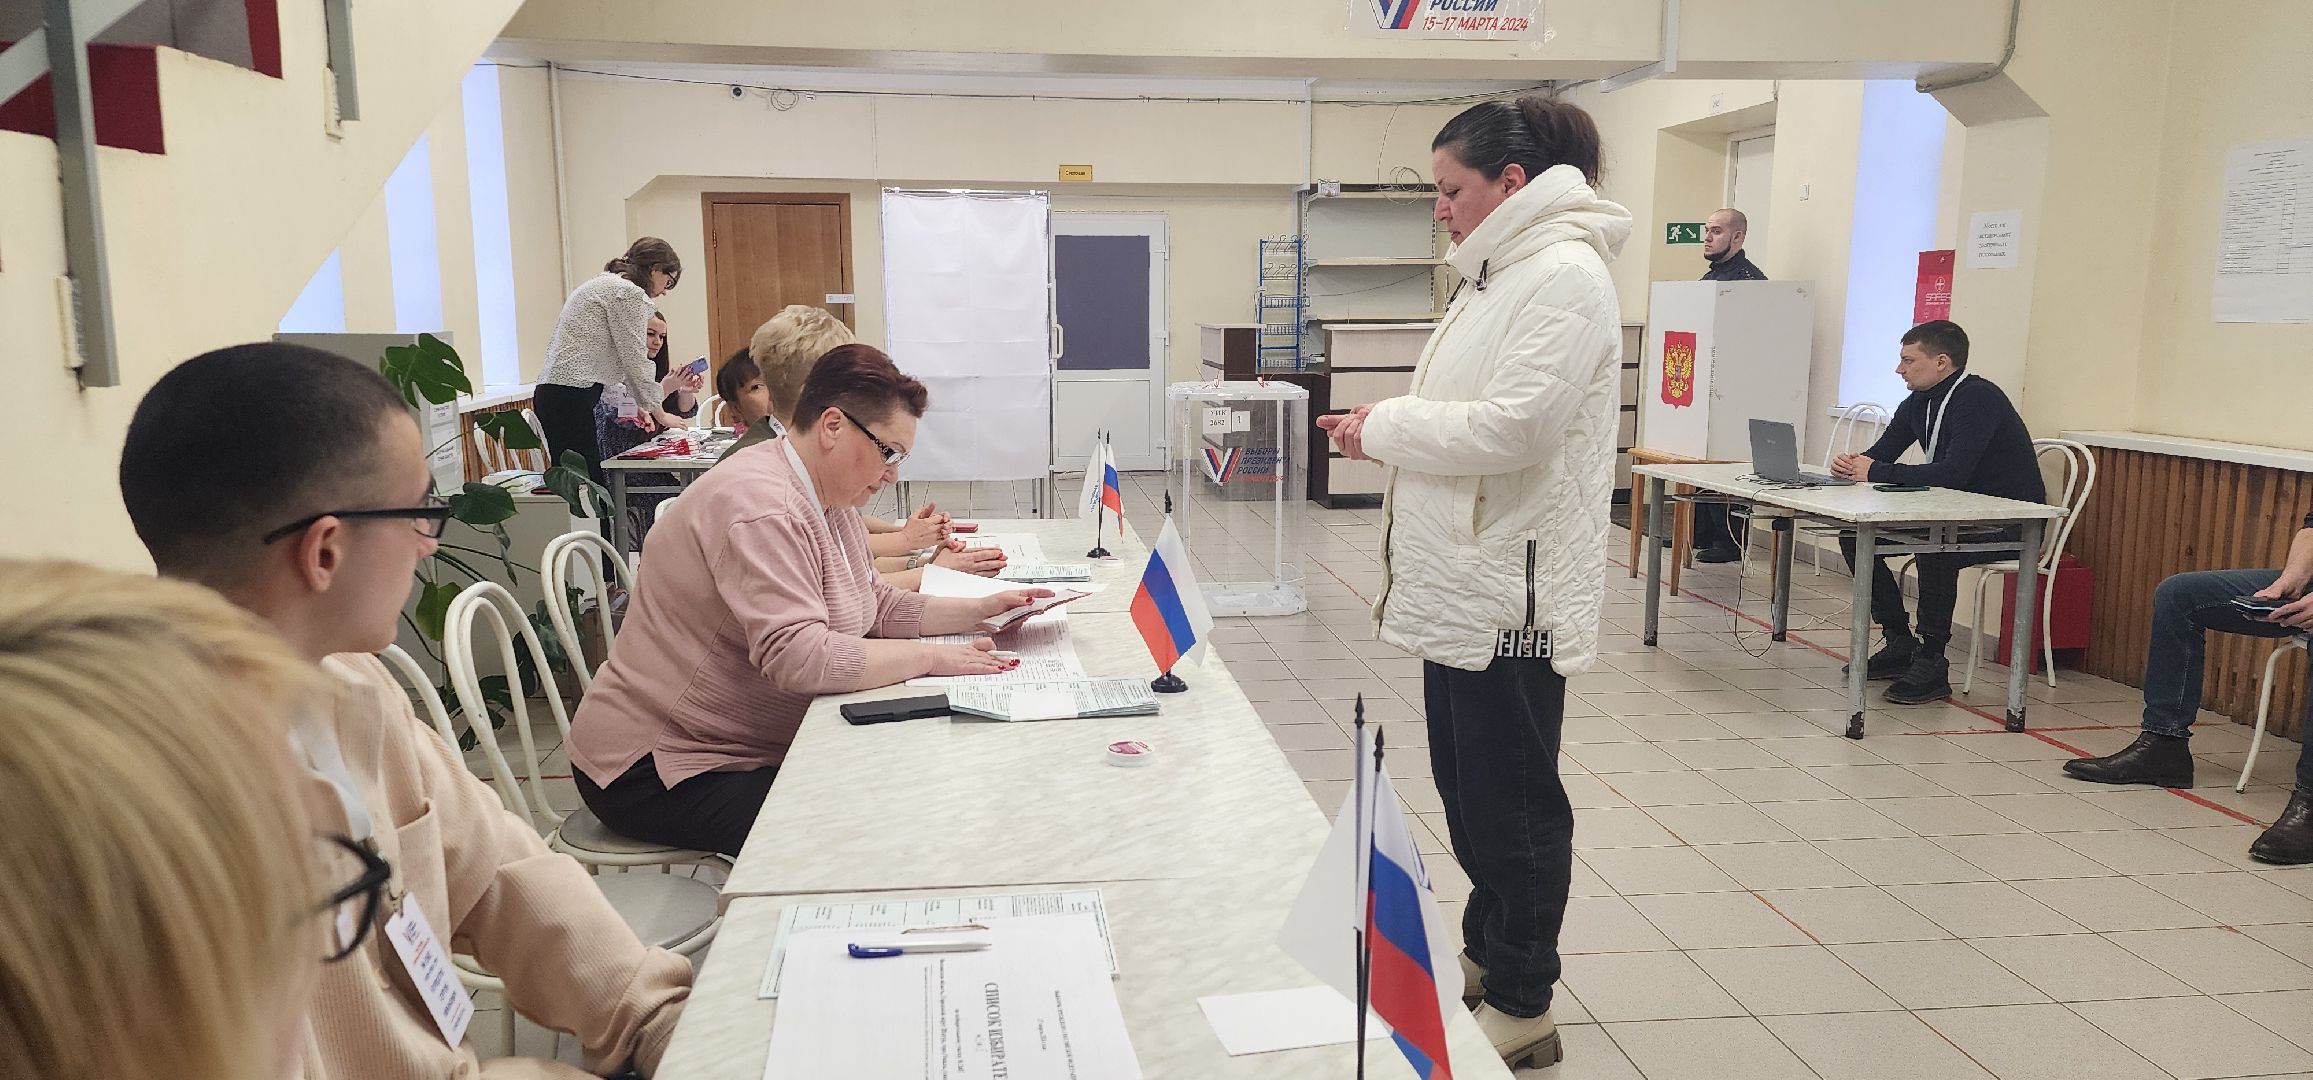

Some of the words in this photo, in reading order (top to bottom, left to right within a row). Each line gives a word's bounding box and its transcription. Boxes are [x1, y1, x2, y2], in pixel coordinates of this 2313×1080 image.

[1430, 0, 1498, 12] РОССИИ
[1457, 16, 1499, 31] МАРТА
[1500, 17, 1529, 32] 2024
[1237, 415, 1241, 424] 1
[1245, 447, 1281, 455] ВЫБОРЫ
[1237, 466, 1269, 474] РОССИИ
[985, 982, 1002, 1027] СПИСОК
